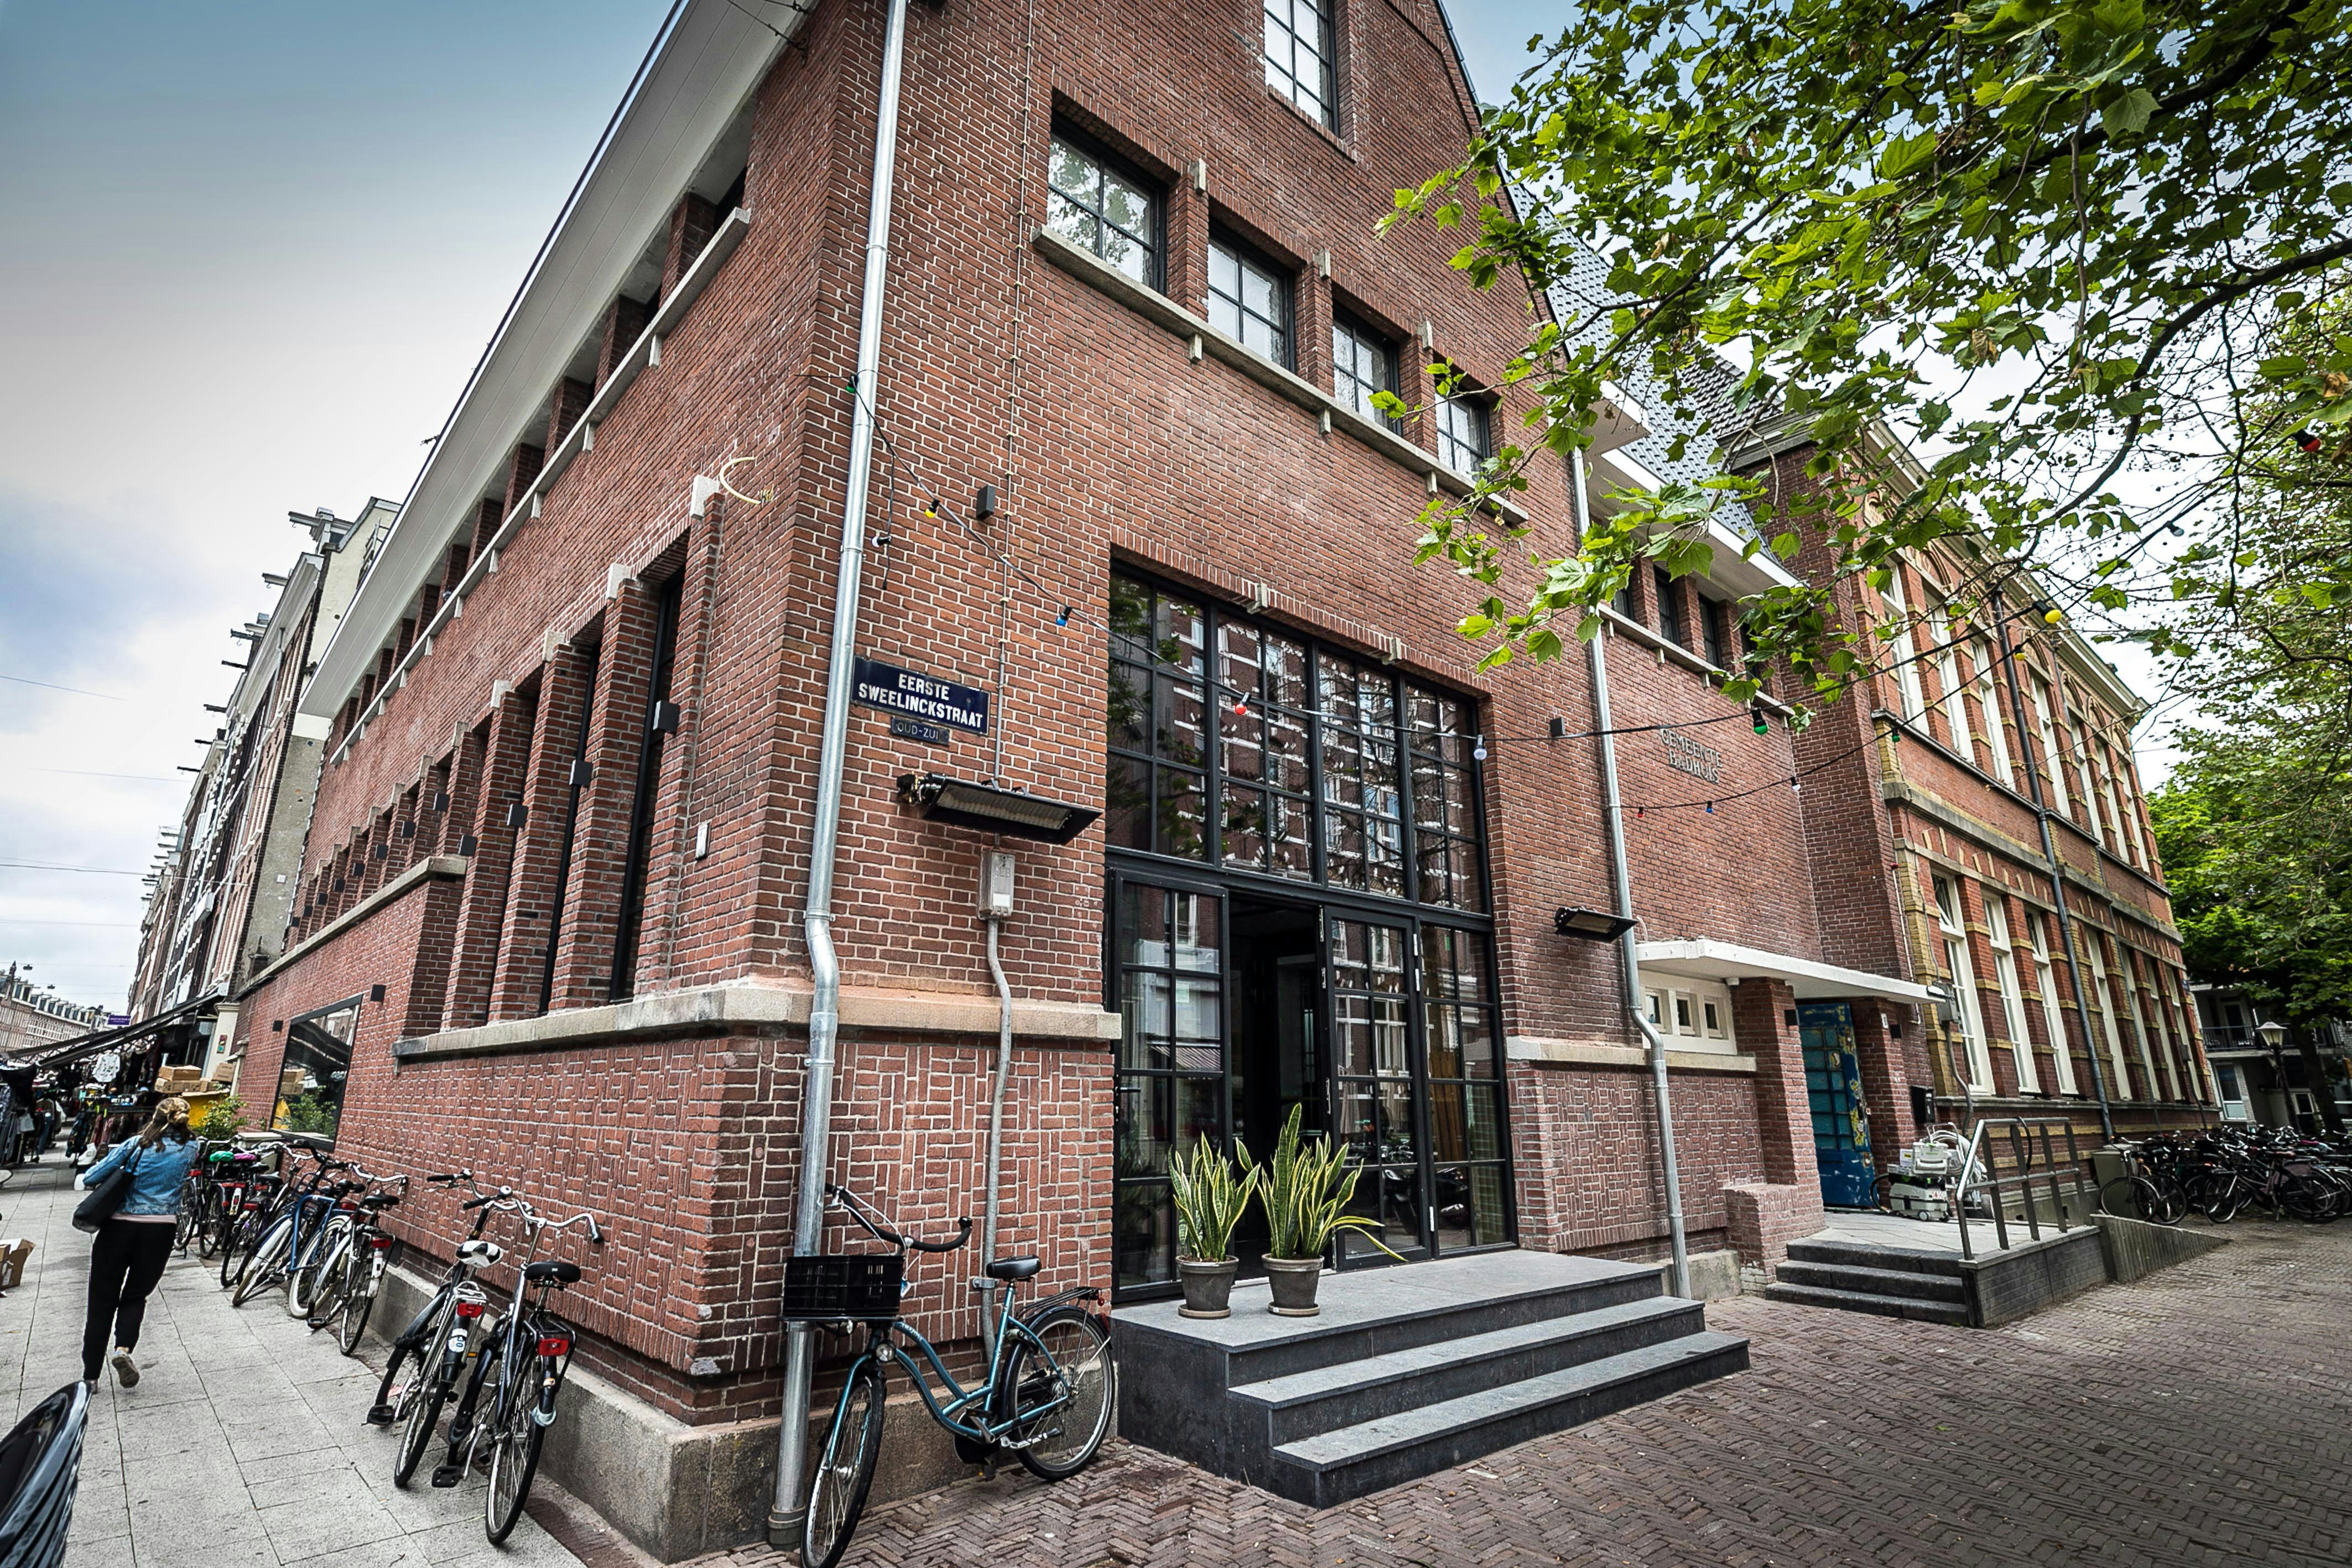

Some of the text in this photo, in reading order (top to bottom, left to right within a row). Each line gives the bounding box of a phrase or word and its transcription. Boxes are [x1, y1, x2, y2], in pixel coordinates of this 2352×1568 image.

[898, 673, 950, 701] EERSTE
[858, 683, 983, 728] SWEELINCKSTRAAT
[897, 721, 941, 741] OUD-ZUI
[1660, 728, 1723, 768] GEMEENTE
[1669, 749, 1720, 784] BADHUIS
